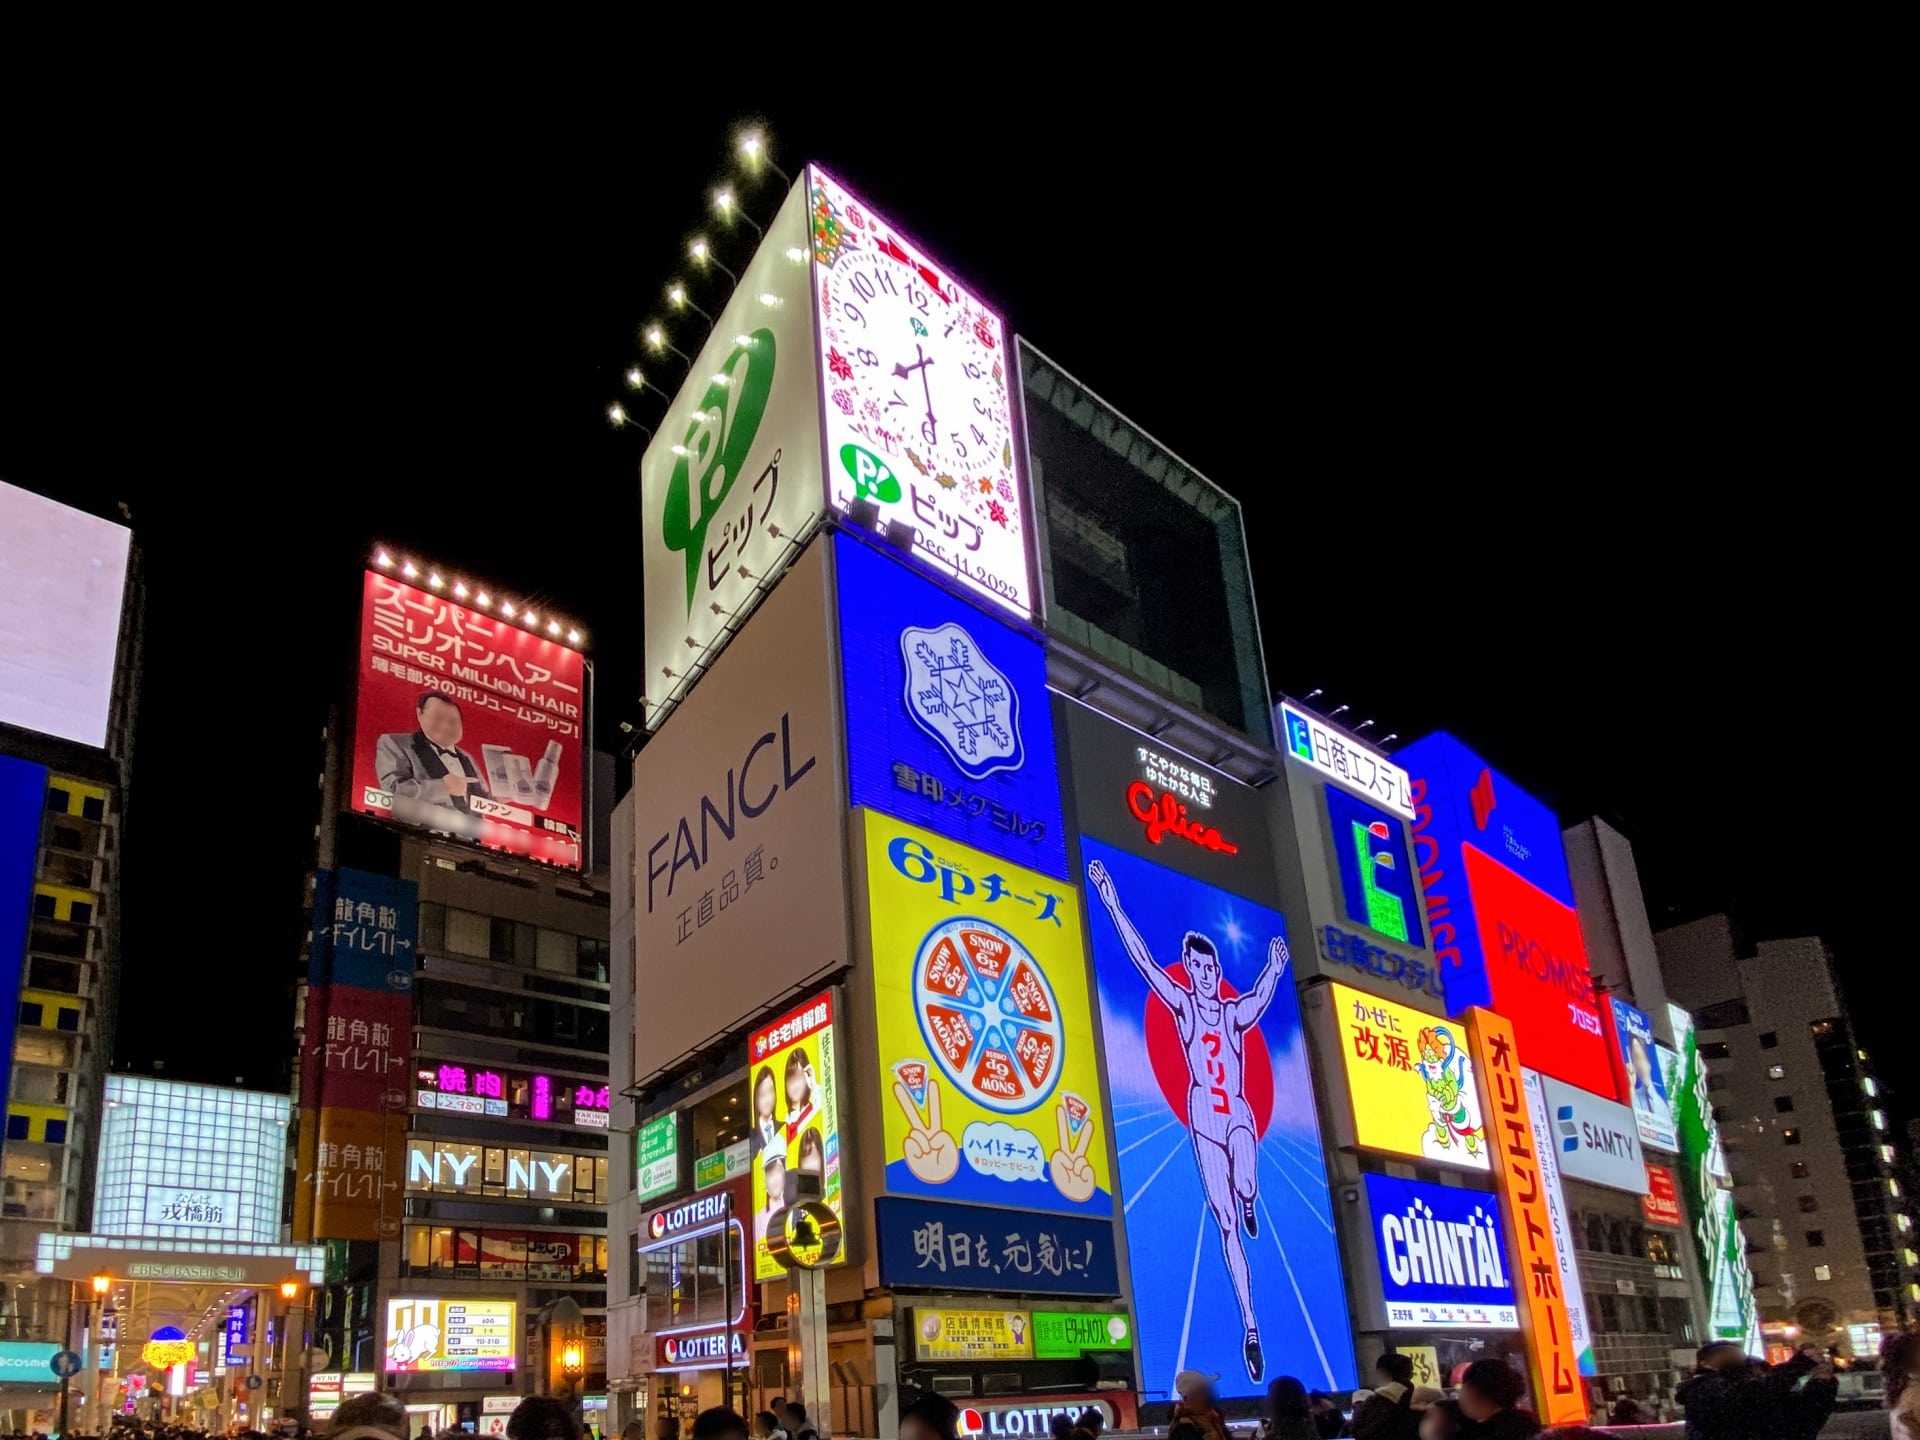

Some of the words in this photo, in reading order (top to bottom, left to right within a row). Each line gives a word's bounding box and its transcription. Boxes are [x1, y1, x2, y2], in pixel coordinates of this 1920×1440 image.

[849, 271, 875, 304] 10
[875, 267, 898, 296] 11
[844, 302, 867, 329] 9
[904, 283, 930, 316] 12
[944, 324, 954, 339] 1
[857, 347, 879, 367] 8
[961, 362, 981, 380] 2
[888, 389, 908, 408] 7
[973, 397, 993, 422] 3
[921, 421, 937, 446] 6
[951, 432, 967, 458] 5
[970, 424, 988, 447] 4
[707, 447, 784, 592] ピップ
[910, 483, 984, 551] ピップ
[374, 582, 494, 638] スーパー
[374, 605, 579, 695] ミリオンヘアー
[372, 634, 445, 672] SUPER
[452, 665, 527, 700] MILLION
[531, 690, 579, 718] HAIR
[1137, 747, 1217, 795] すこやかな毎日、
[1145, 766, 1211, 808] ゆたかな人生
[474, 798, 513, 817] ルアン
[646, 712, 817, 913] FANCL
[1127, 780, 1238, 855] Glico
[334, 896, 397, 930] 龍角散
[674, 846, 779, 947] 正直品質。
[320, 926, 405, 956] ダイレクト
[969, 934, 1003, 954] SNOW
[929, 943, 951, 984] SNOW
[1497, 920, 1599, 1009] PROMISE
[1022, 971, 1049, 1012] SNOW
[326, 1014, 391, 1047] 龍角散
[768, 1002, 828, 1050] 住宅情報館
[1353, 1000, 1402, 1033] かぜに
[1568, 1002, 1603, 1037] プロミス
[930, 1015, 960, 1060] SNOW
[1351, 1024, 1413, 1072] 改源
[1032, 1041, 1051, 1082] SNOW
[1200, 1030, 1231, 1115] グリコ
[439, 1065, 501, 1097] 焼肉
[981, 1077, 1016, 1095] SNOW
[318, 1142, 383, 1171] 龍角散
[1582, 1121, 1634, 1161] SAMTY
[410, 1149, 477, 1185] NY
[508, 1158, 568, 1193] NY
[161, 1205, 224, 1224] 戎橋筋
[175, 1192, 213, 1204] なんば
[666, 1190, 728, 1231] LOTTERIA
[1488, 1033, 1574, 1396] オリエントホーム
[1381, 1200, 1505, 1288] CHINTAI
[131, 1264, 169, 1277] EBISU
[679, 1332, 742, 1358] LOTTERA
